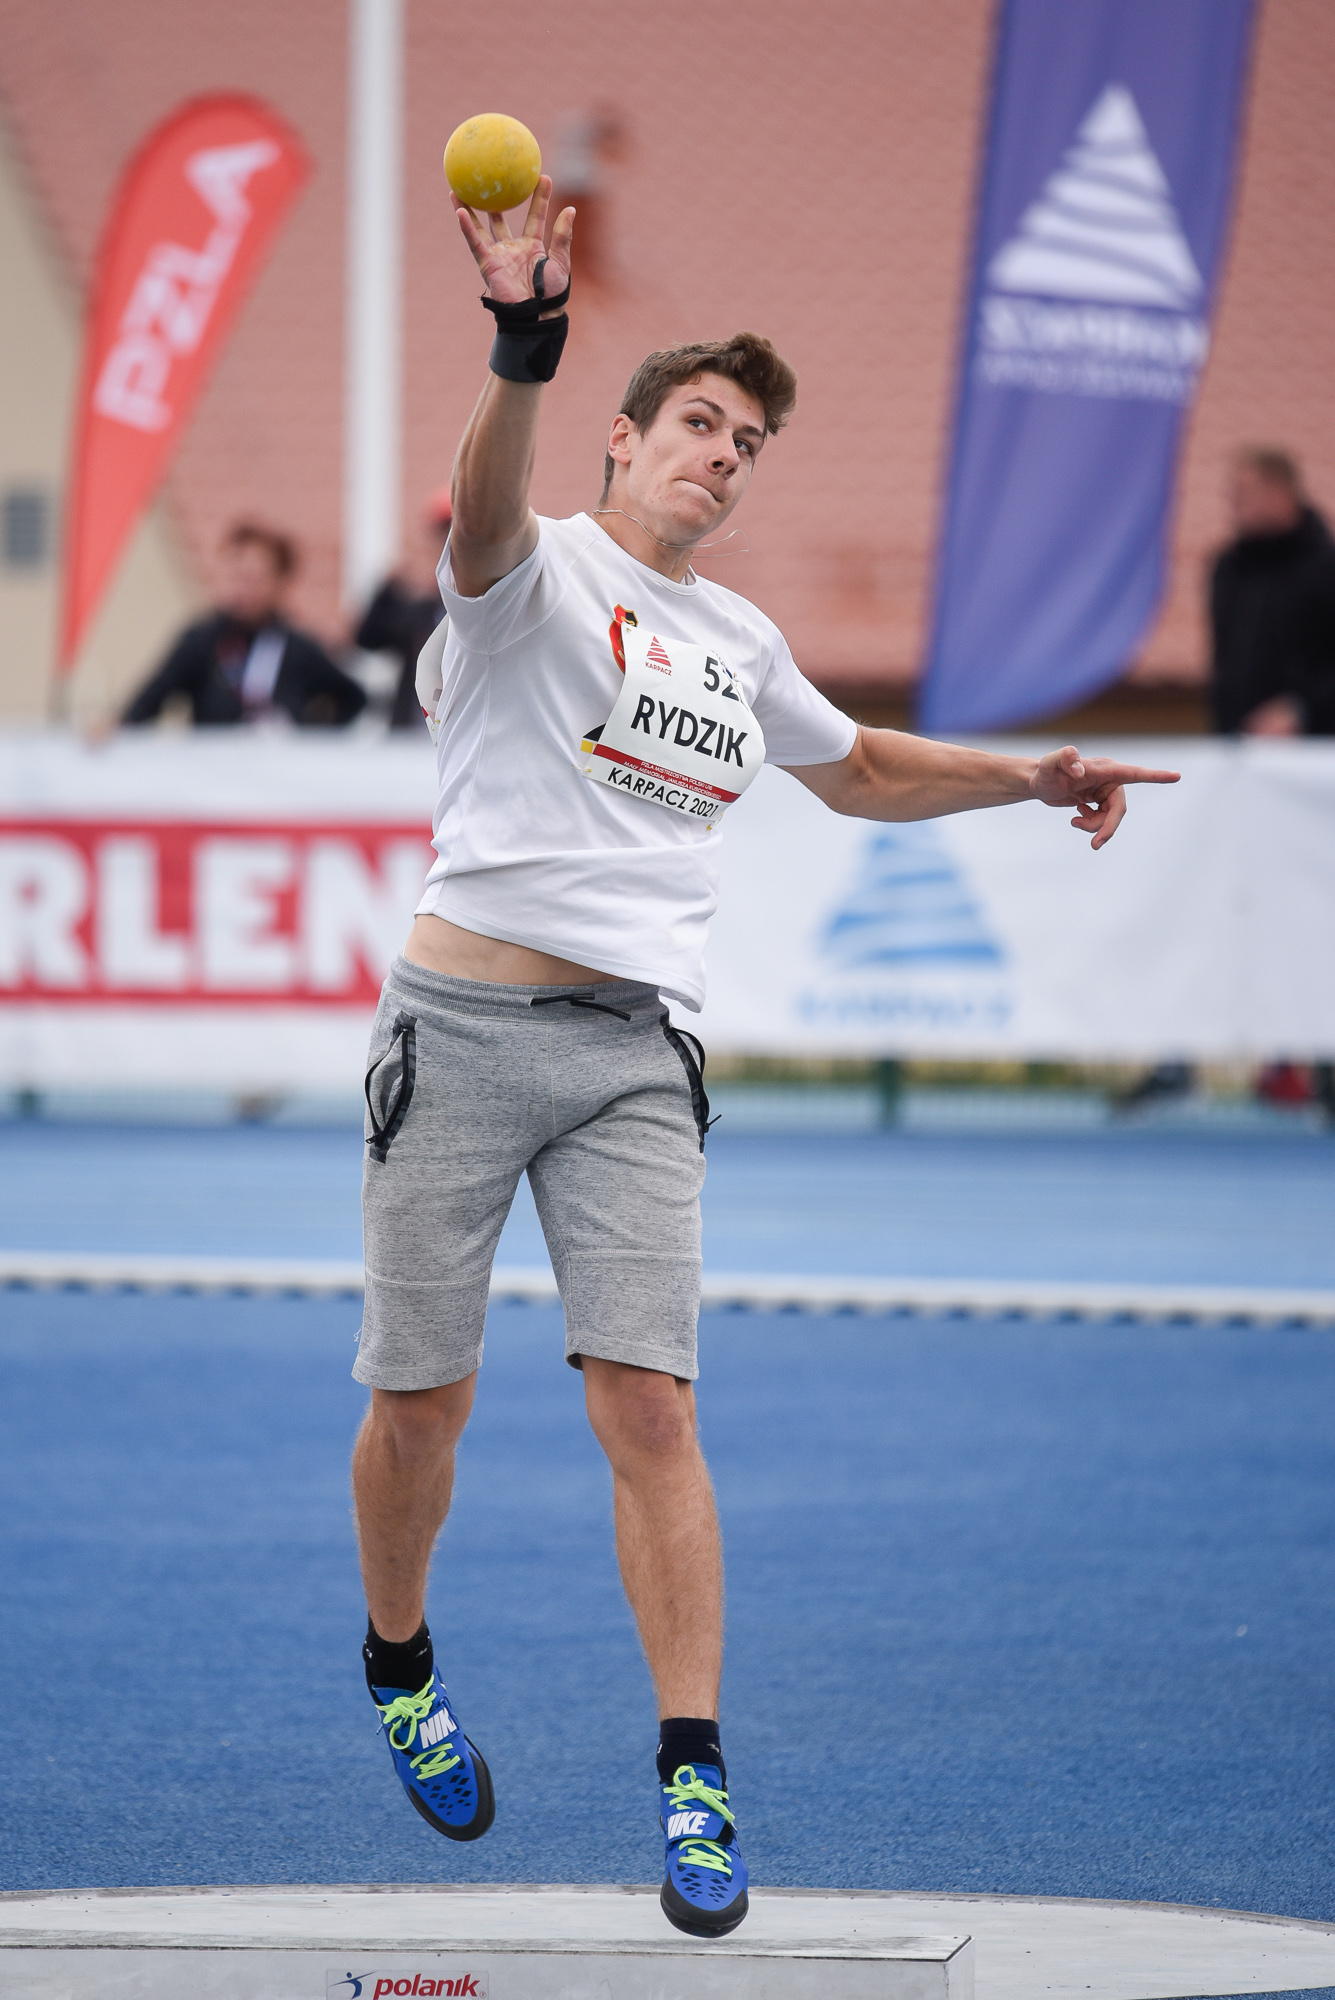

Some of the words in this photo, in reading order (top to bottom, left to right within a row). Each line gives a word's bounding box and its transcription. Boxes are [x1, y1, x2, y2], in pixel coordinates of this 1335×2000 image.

[94, 138, 281, 434] PZLA
[645, 661, 672, 676] KARPACZ
[630, 693, 748, 769] RYDZIK
[607, 766, 690, 811] KARPACZ
[688, 797, 720, 819] 2021
[418, 1706, 458, 1750] NIK
[373, 1973, 480, 2000] polanik
